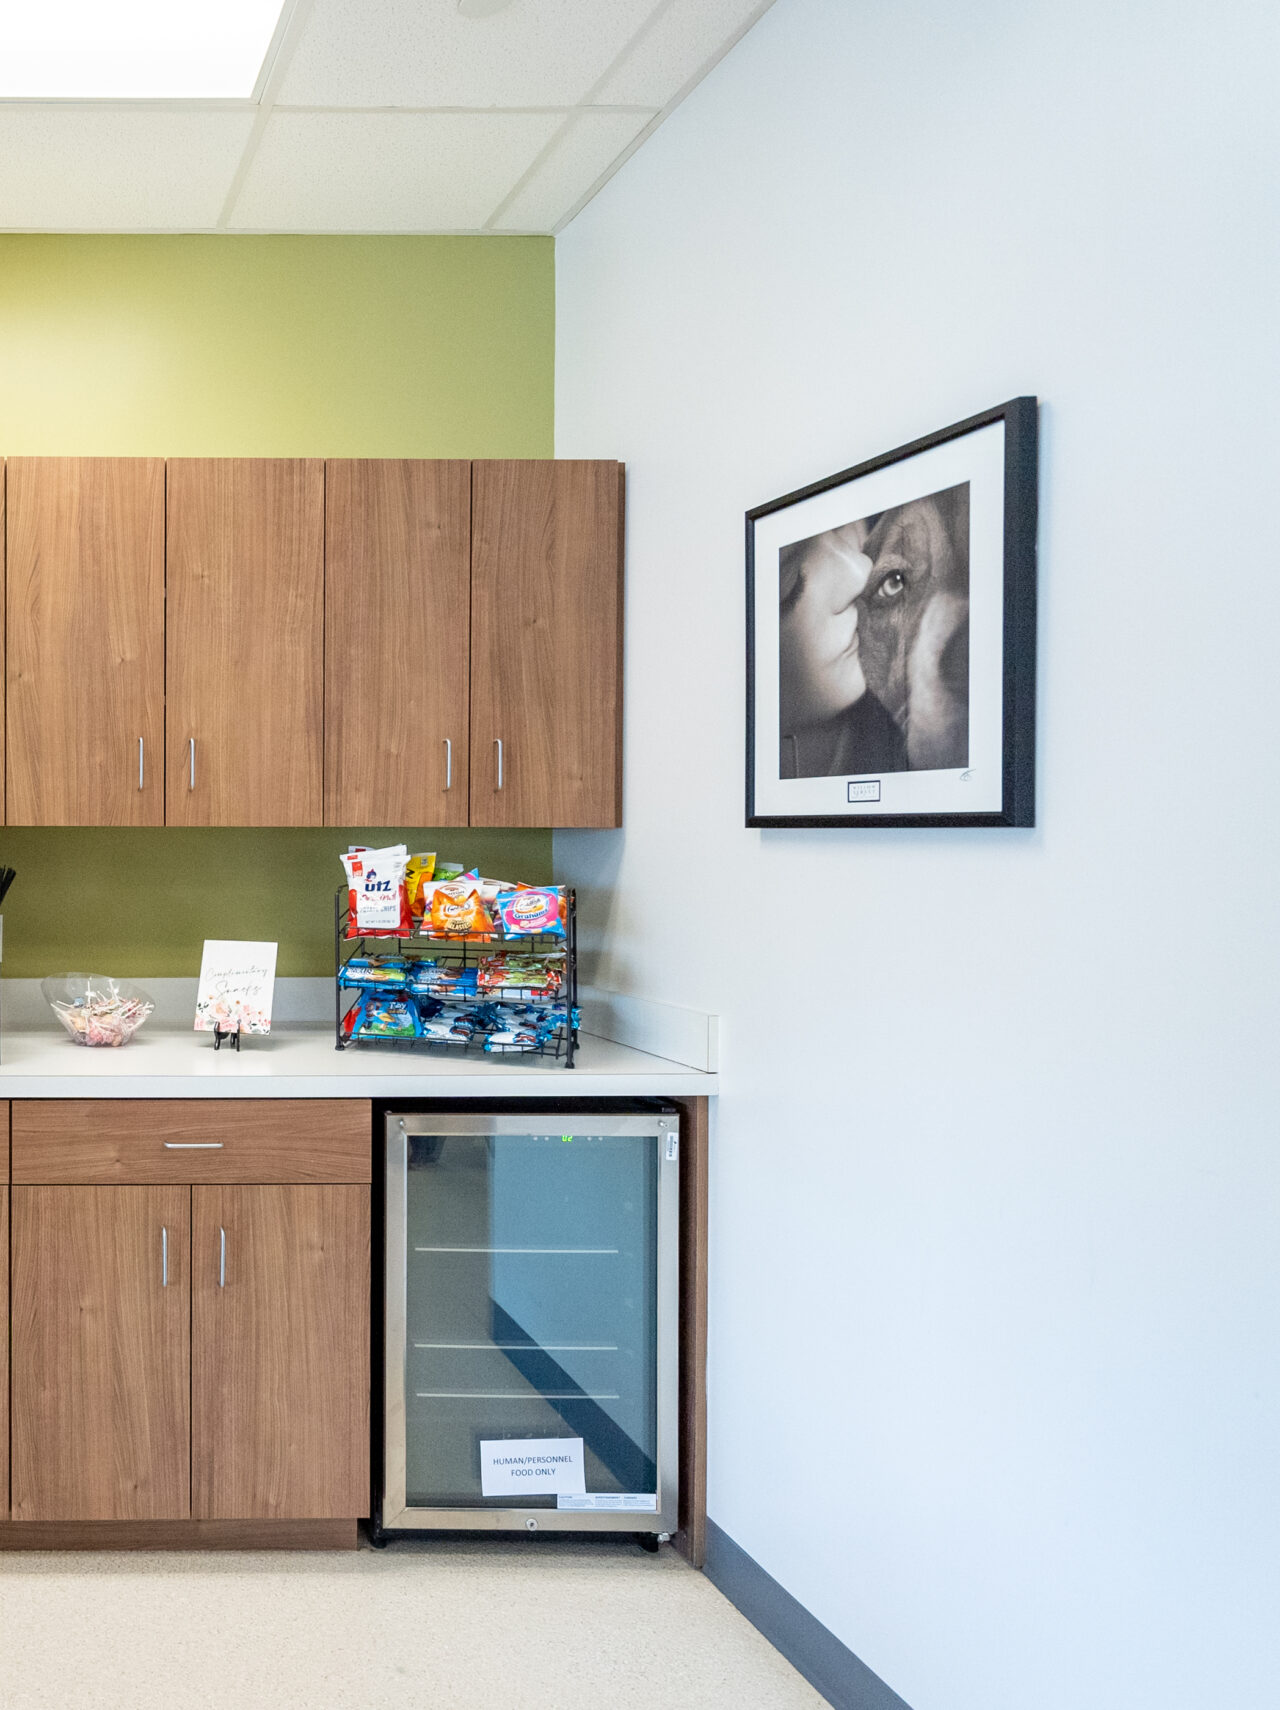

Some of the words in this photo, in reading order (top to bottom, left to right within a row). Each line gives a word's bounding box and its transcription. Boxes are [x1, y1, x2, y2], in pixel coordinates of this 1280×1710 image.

[364, 880, 392, 892] utz
[493, 1455, 573, 1466] HUMAN/PERSONNEL
[511, 1469, 534, 1477] FOOD
[535, 1468, 556, 1477] ONLY
